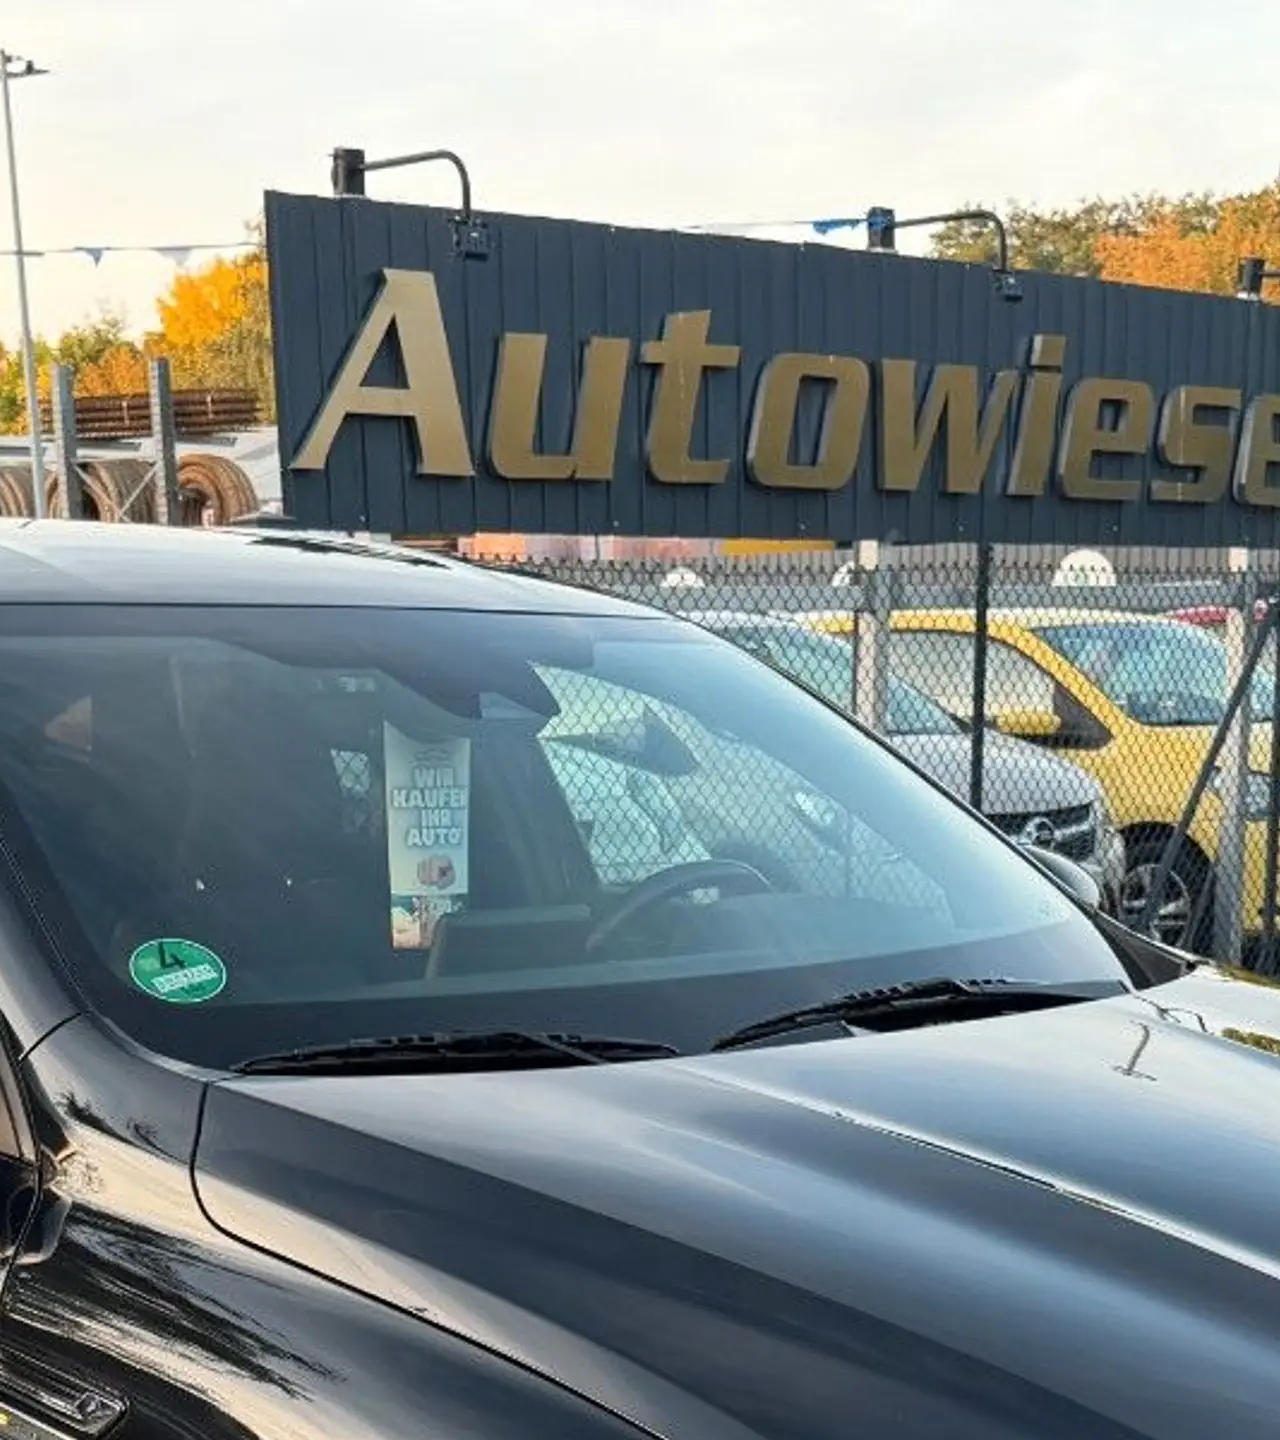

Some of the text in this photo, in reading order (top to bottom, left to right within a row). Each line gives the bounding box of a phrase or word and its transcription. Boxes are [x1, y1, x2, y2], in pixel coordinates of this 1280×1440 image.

[413, 767, 455, 787] WIR
[421, 809, 452, 827] IHR
[406, 828, 462, 847] AUTO
[157, 939, 187, 969] 4
